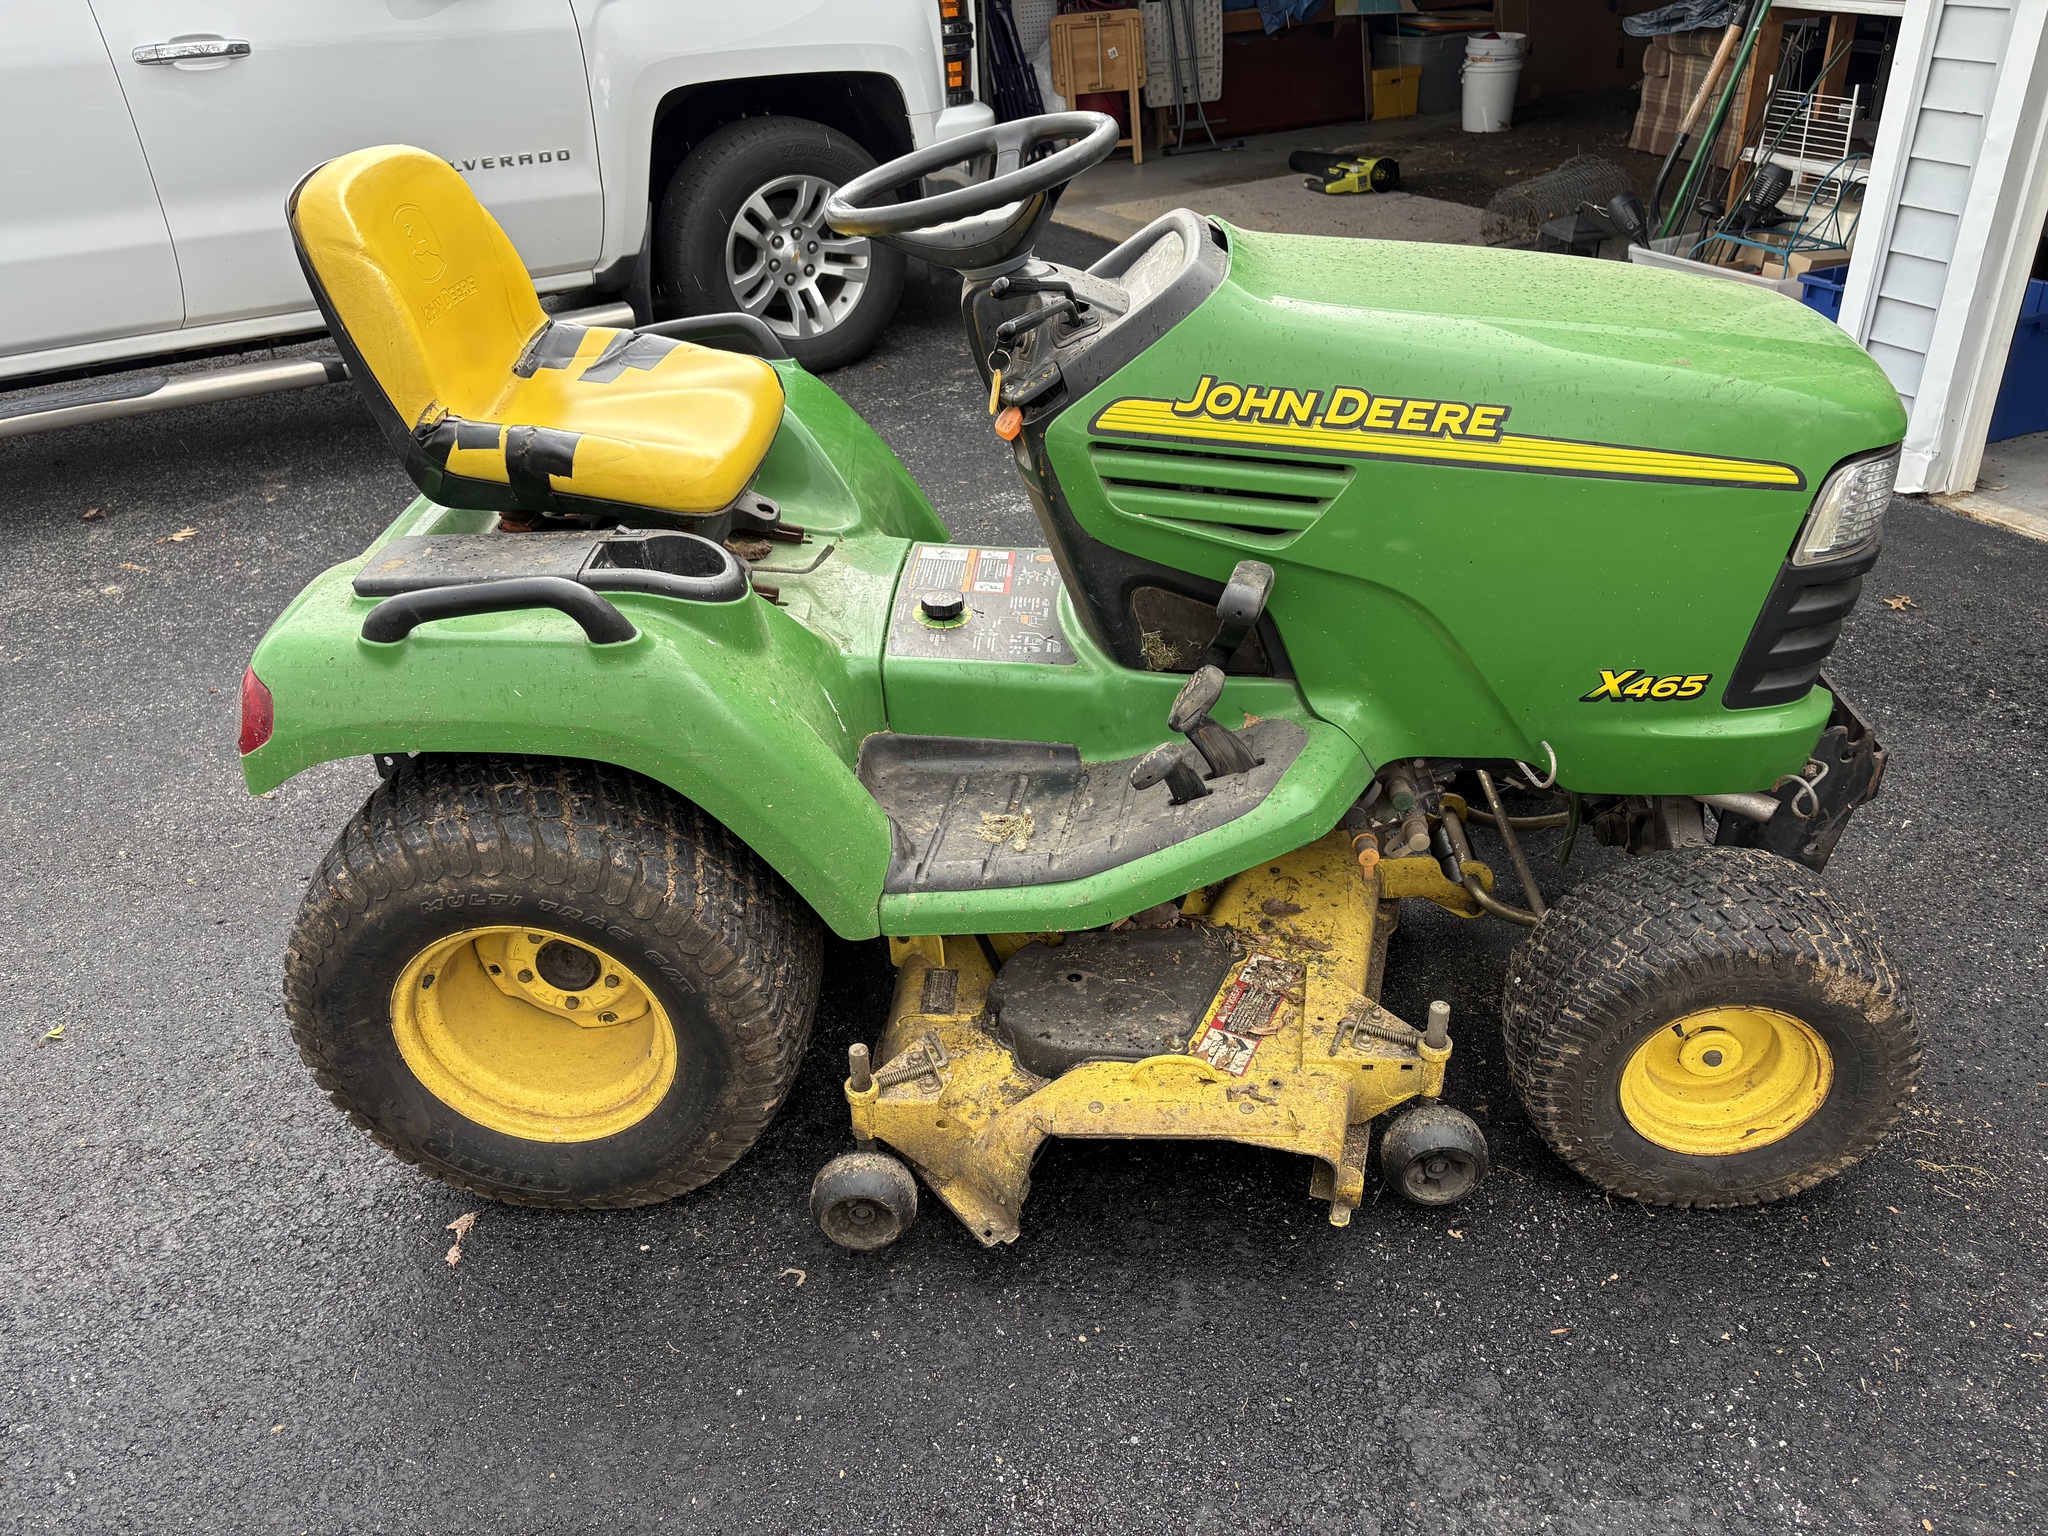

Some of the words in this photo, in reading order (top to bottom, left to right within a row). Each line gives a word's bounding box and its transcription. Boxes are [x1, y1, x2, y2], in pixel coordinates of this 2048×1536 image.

[452, 149, 571, 172] LVERADO
[420, 294, 447, 330] JOHN
[441, 275, 479, 310] DEERE
[1171, 374, 1319, 424] JOHN
[1322, 386, 1507, 439] DEERE
[1581, 670, 1712, 701] X465
[420, 893, 525, 915] MULTI
[538, 899, 634, 942] TRAC
